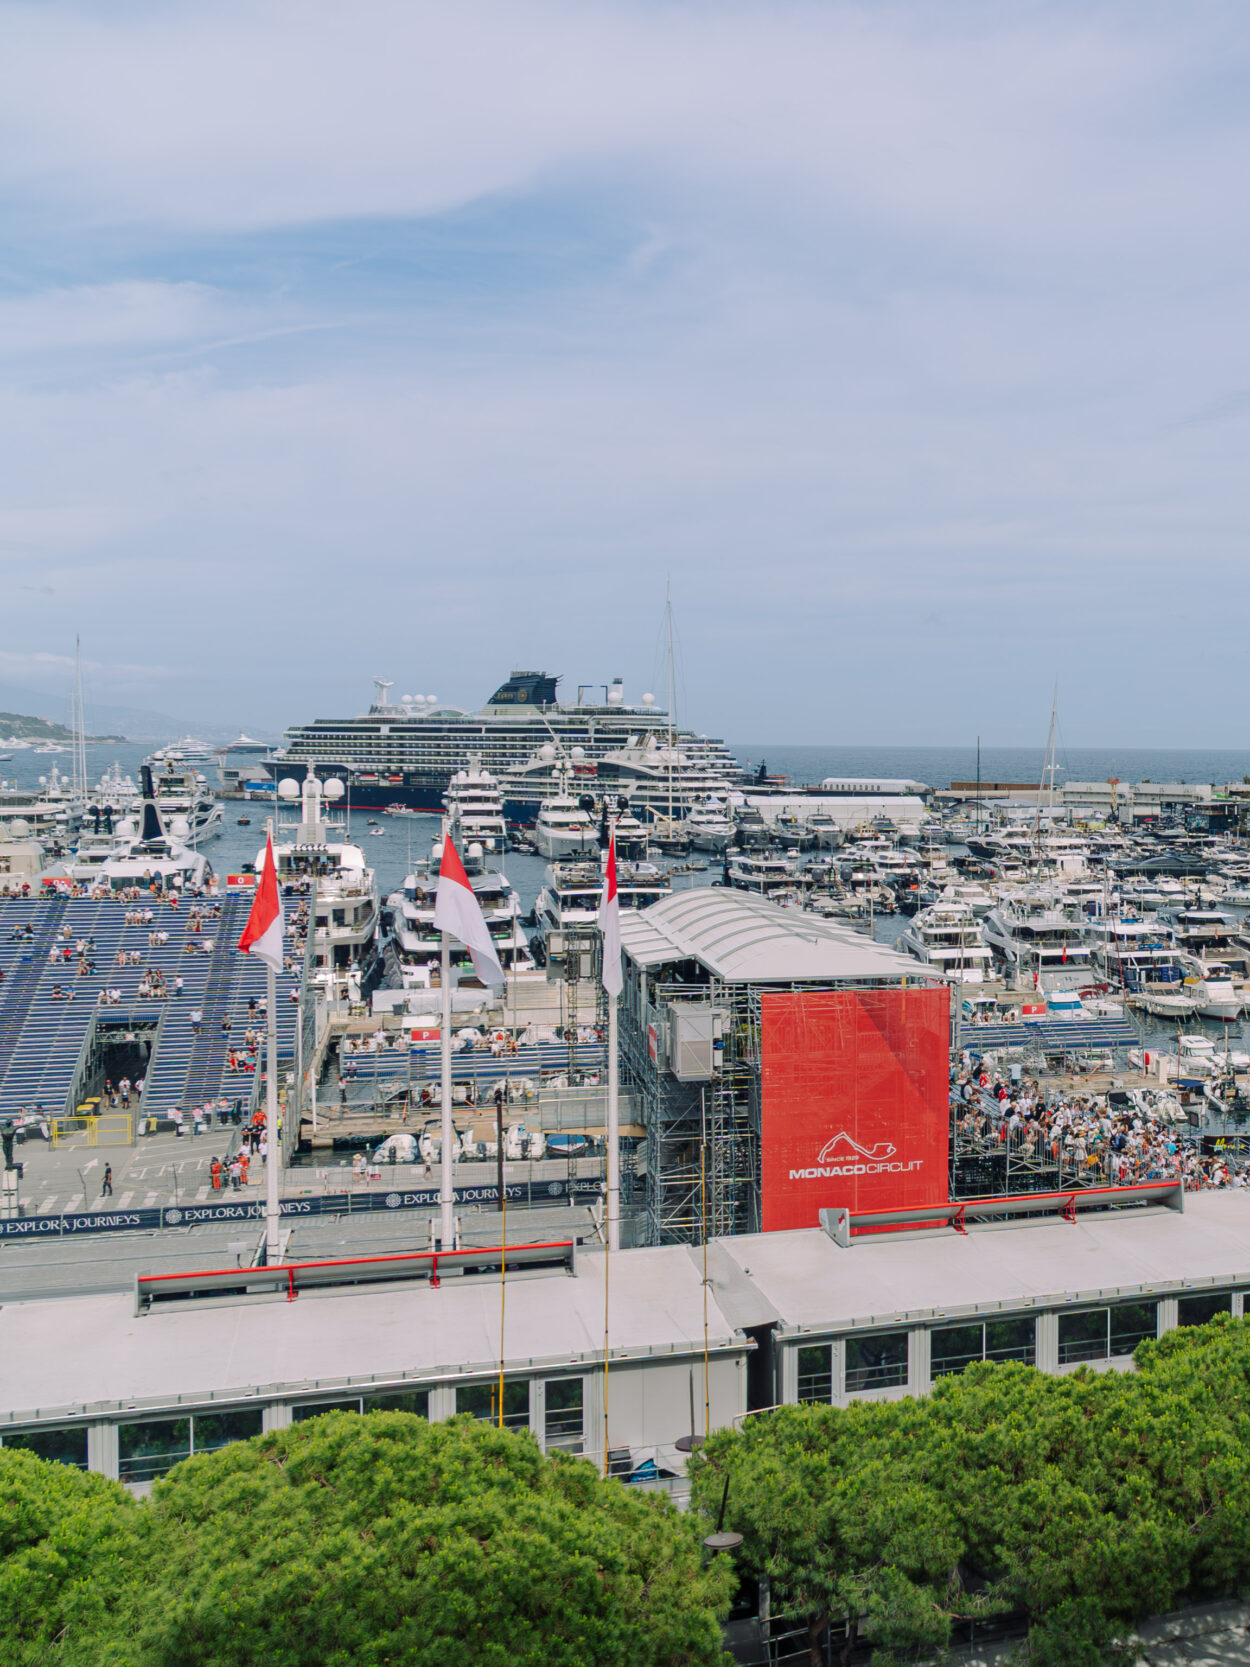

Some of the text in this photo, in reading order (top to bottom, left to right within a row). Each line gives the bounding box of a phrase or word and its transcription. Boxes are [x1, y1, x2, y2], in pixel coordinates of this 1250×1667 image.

[422, 1031, 430, 1040] P
[184, 1206, 245, 1221] EXPLORA
[6, 1214, 140, 1233] EXPLORA JOURNEYS
